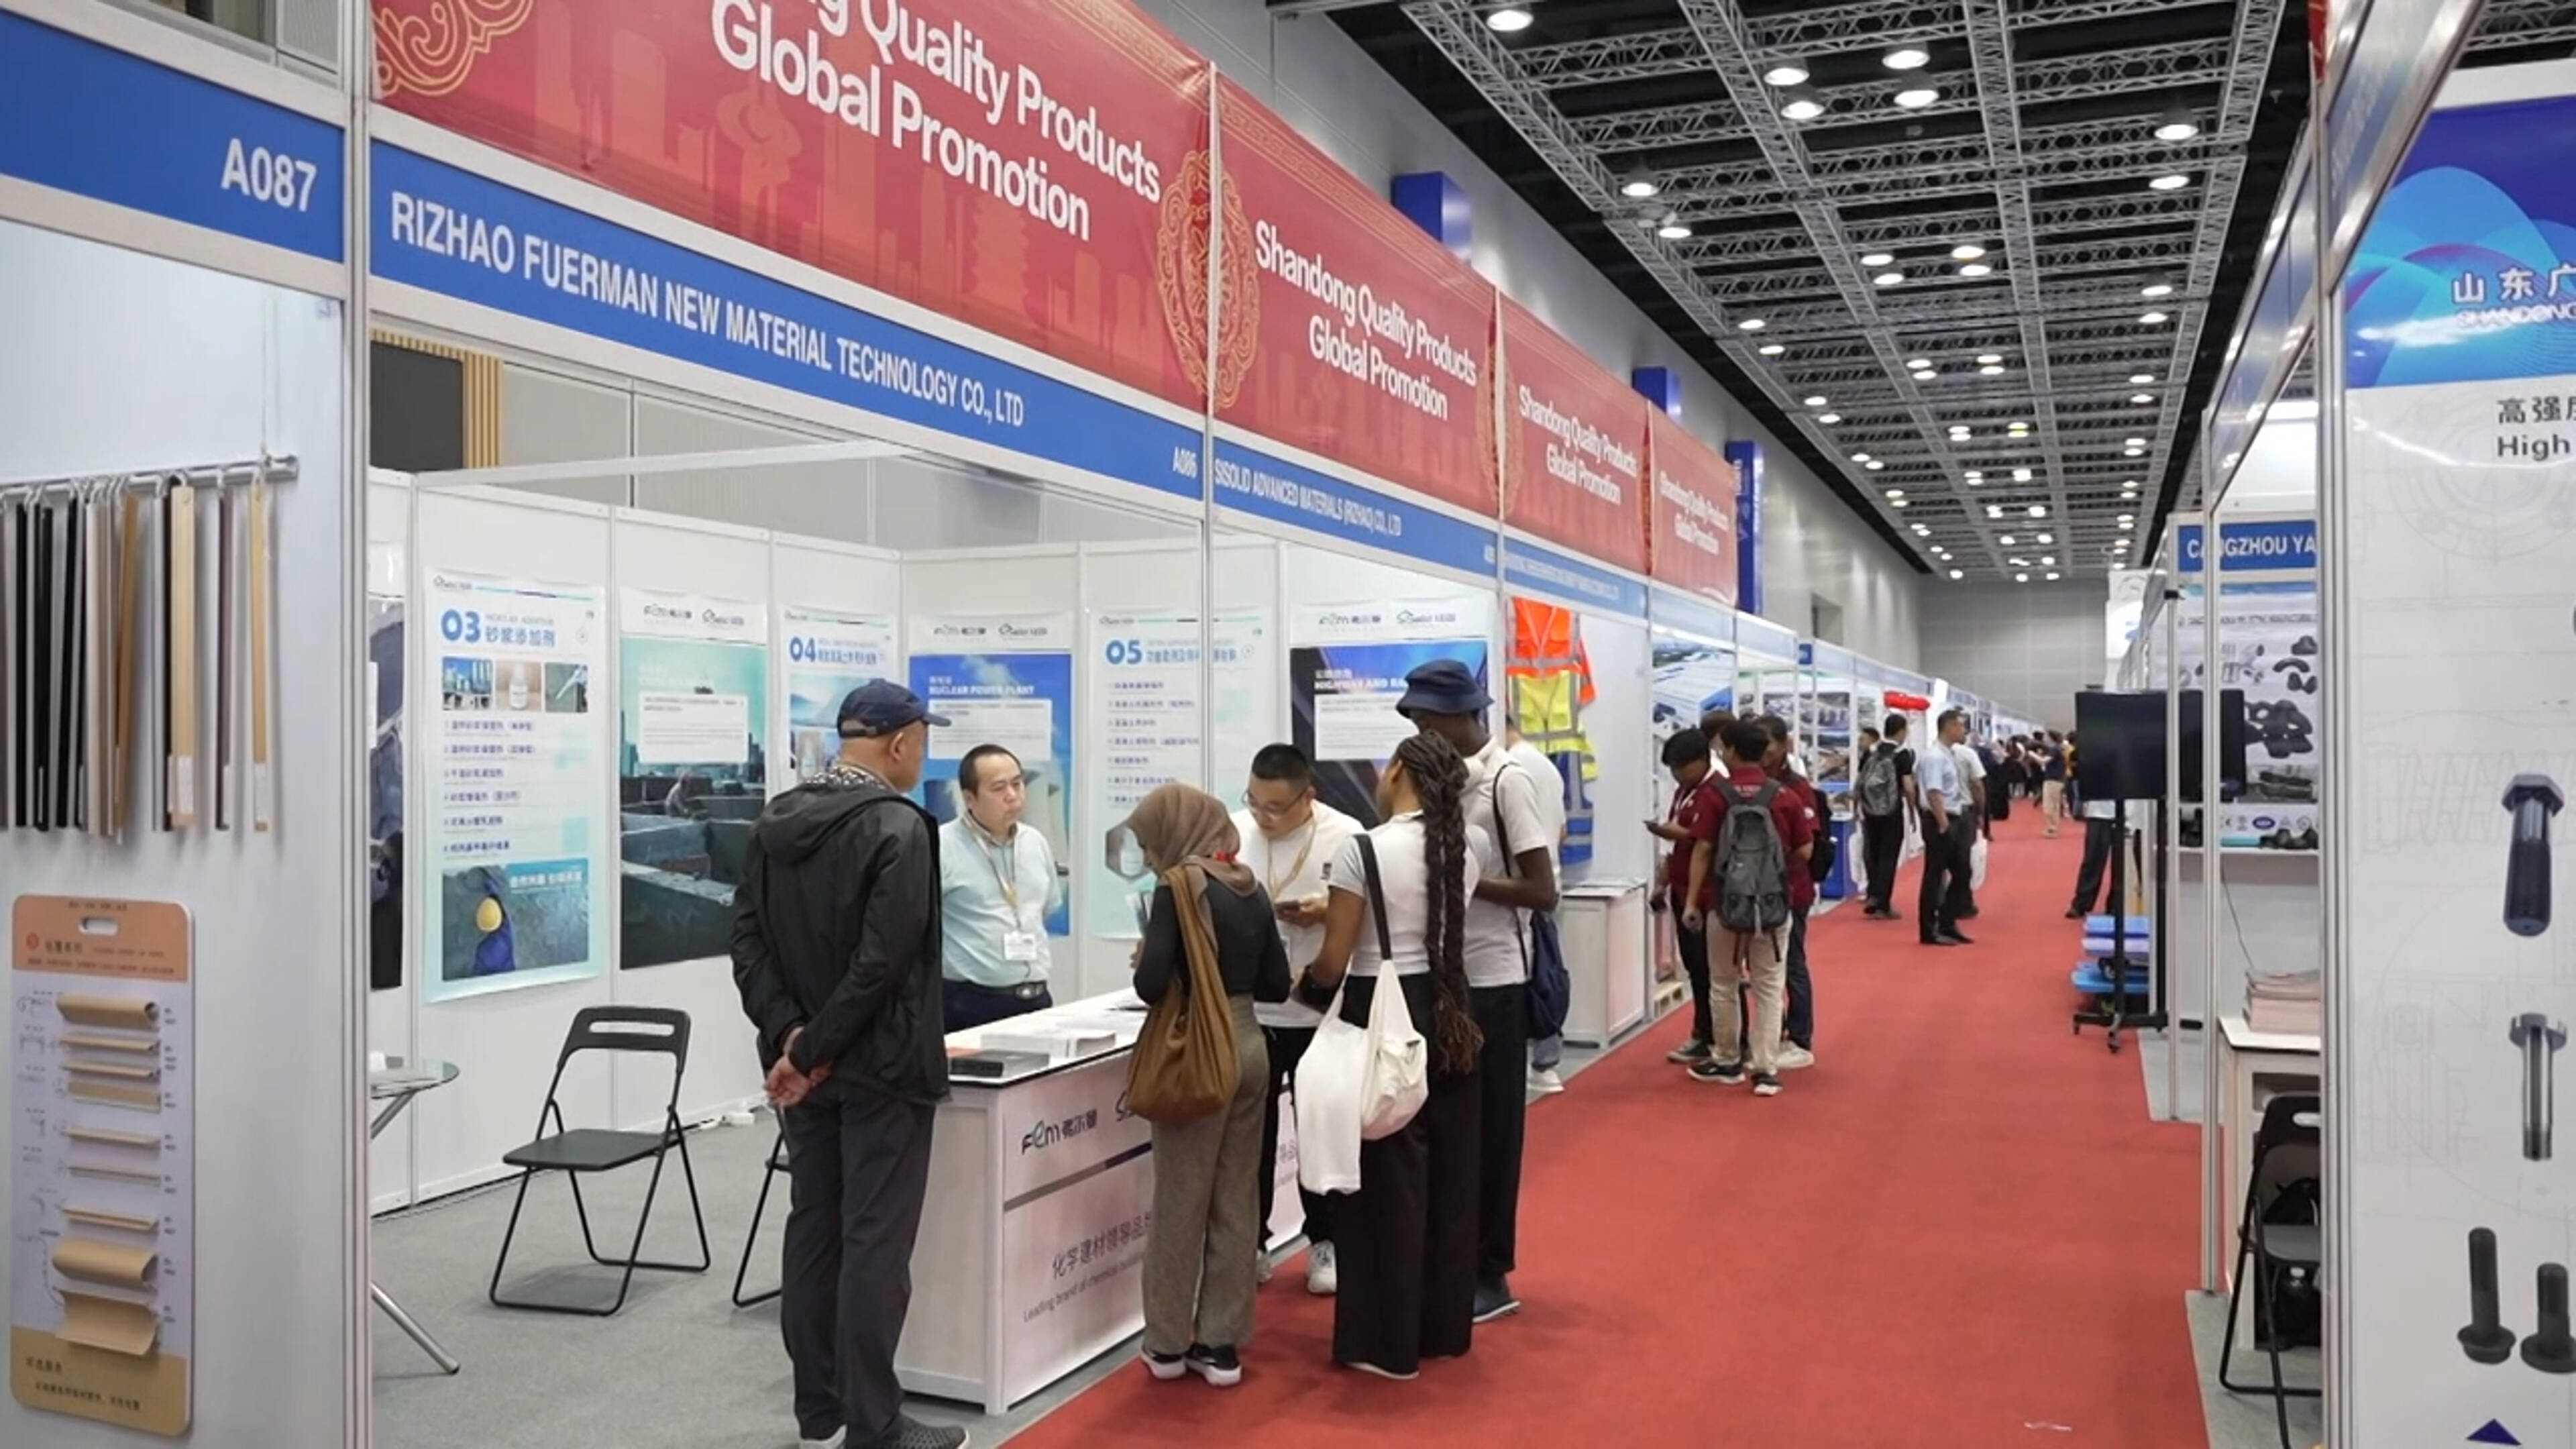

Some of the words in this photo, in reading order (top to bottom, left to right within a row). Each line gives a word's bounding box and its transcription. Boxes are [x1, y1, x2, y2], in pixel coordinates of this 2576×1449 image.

[712, 0, 880, 138] Global
[893, 80, 1089, 242] Promotion
[861, 0, 1010, 125] Quality
[1018, 64, 1161, 203] Products
[221, 138, 317, 212] A087
[392, 191, 515, 273] RIZHAO
[524, 234, 658, 318] FUERMAN
[666, 282, 720, 334] NEW
[726, 301, 831, 371] MATERIAL
[837, 337, 958, 406] TECHNOLOGY
[961, 377, 993, 424] CO.,
[996, 389, 1023, 427] LTD
[1255, 220, 1355, 327] Shandong
[1358, 283, 1415, 360] Quality
[1416, 318, 1477, 387] Products
[1309, 315, 1367, 381] Global
[1371, 345, 1448, 421] Promotion
[2498, 435, 2571, 462] High
[2187, 535, 2287, 558] CGZHOU
[441, 608, 481, 643] 03
[790, 636, 816, 663] 04
[1106, 639, 1143, 665] 05
